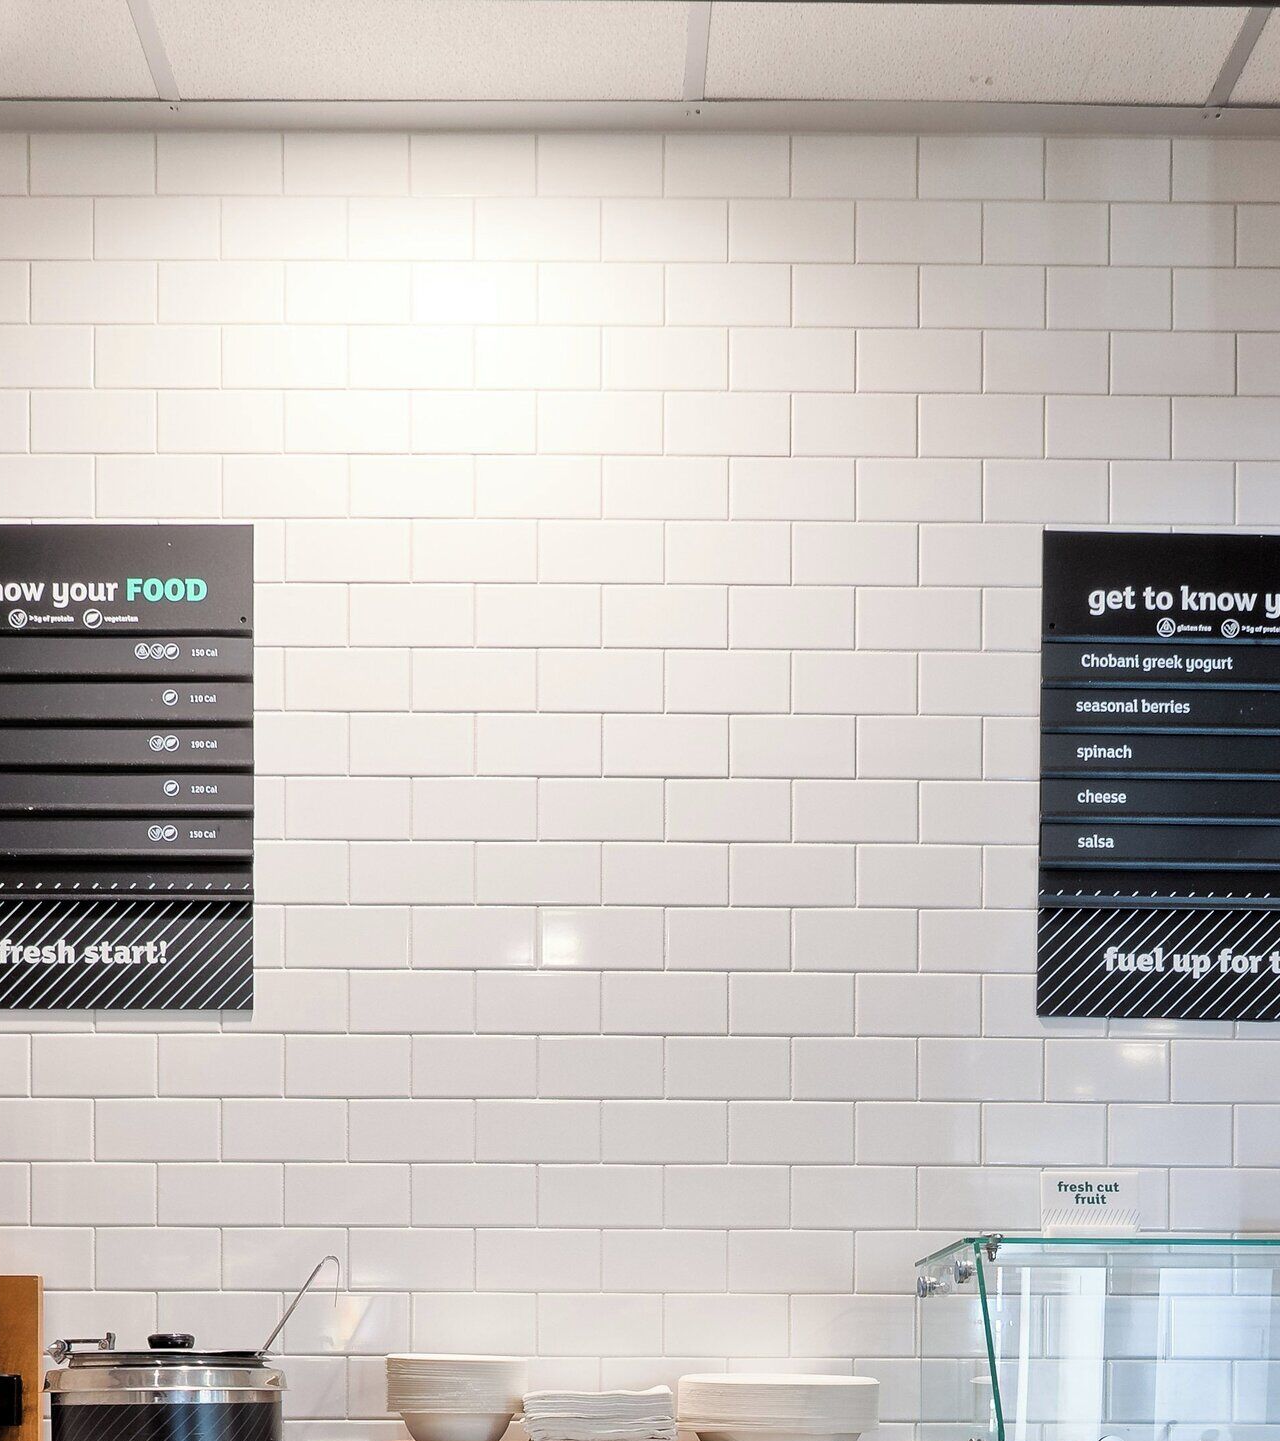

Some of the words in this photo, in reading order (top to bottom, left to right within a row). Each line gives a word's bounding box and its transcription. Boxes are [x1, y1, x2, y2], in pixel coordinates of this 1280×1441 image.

[53, 583, 119, 608] your
[127, 578, 207, 601] FOOD
[1088, 586, 1135, 615] get
[1143, 587, 1173, 610] to
[1181, 585, 1257, 611] know
[191, 648, 205, 657] 150
[206, 648, 218, 657] Cal
[1082, 654, 1139, 668] Chobani
[1143, 655, 1182, 671] greek
[1186, 657, 1233, 672] yogurt
[190, 694, 203, 703] 110
[204, 694, 217, 703] Cal
[1076, 699, 1138, 712] seasonal
[1141, 699, 1190, 713] berries
[191, 740, 205, 749] 190
[205, 740, 218, 749] Cal
[1077, 745, 1131, 761] spinach
[191, 785, 204, 794] 120
[205, 785, 218, 794] Cal
[1078, 789, 1126, 803] cheese
[189, 830, 203, 839] 150
[203, 830, 216, 839] Cal
[1078, 835, 1114, 848] salsa
[85, 941, 168, 964] start!
[1104, 947, 1164, 972] fuel
[1173, 953, 1211, 979] up
[1218, 949, 1263, 974] for
[1058, 1181, 1092, 1192] fresh
[1096, 1182, 1120, 1193] cut
[1075, 1193, 1106, 1204] fruit
